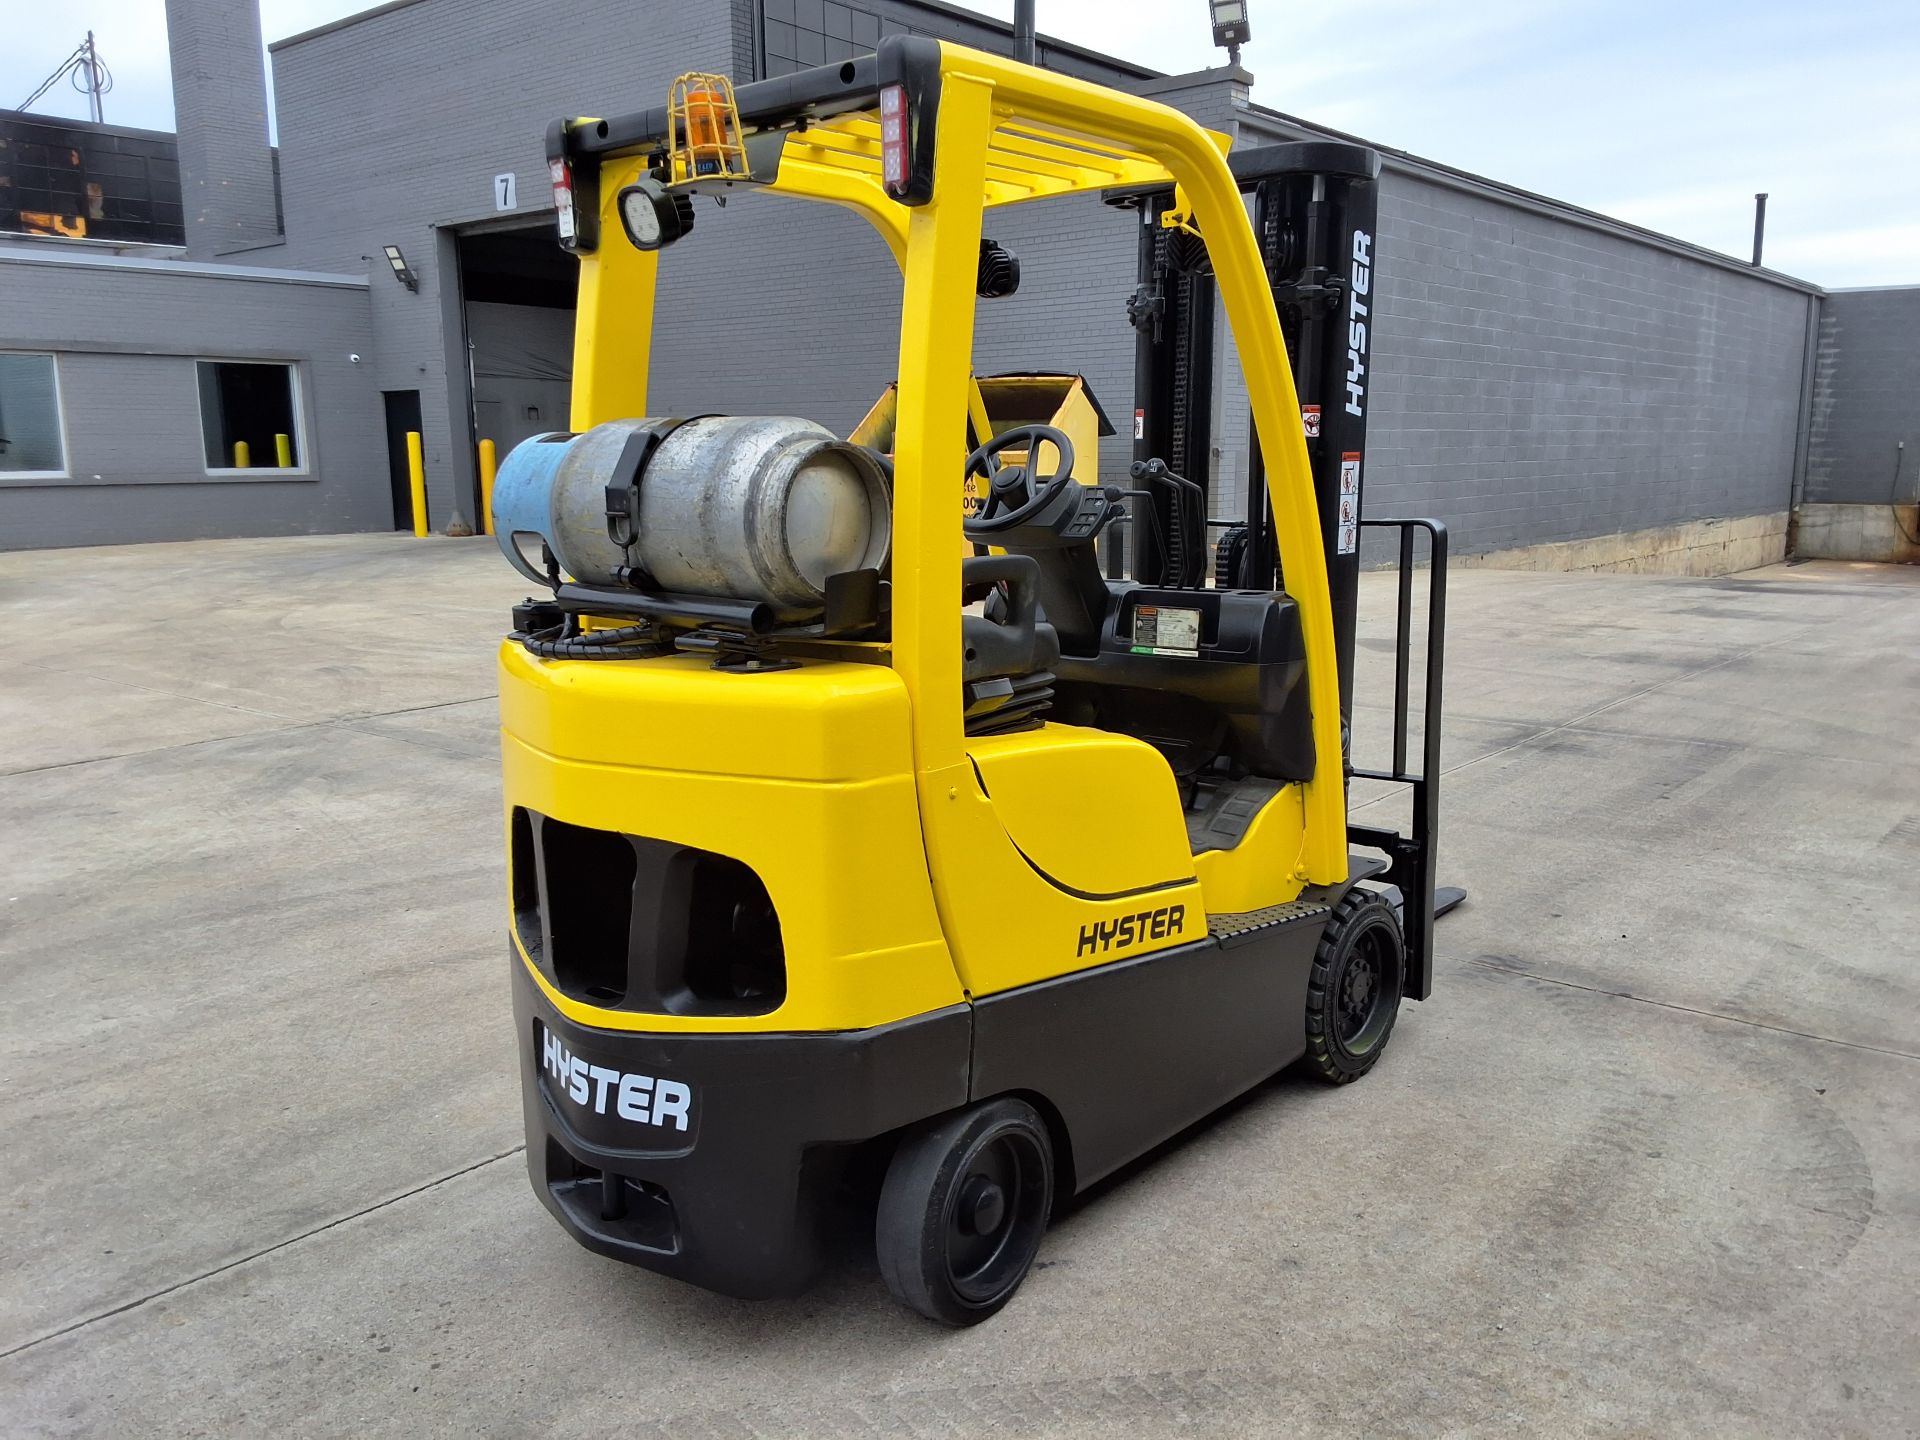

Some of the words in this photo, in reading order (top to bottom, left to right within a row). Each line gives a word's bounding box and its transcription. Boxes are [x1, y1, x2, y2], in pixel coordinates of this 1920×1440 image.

[500, 178, 509, 206] 7
[1345, 229, 1371, 417] HYSTER
[1076, 904, 1185, 958] HYSTER
[543, 1025, 691, 1132] HYSTER
